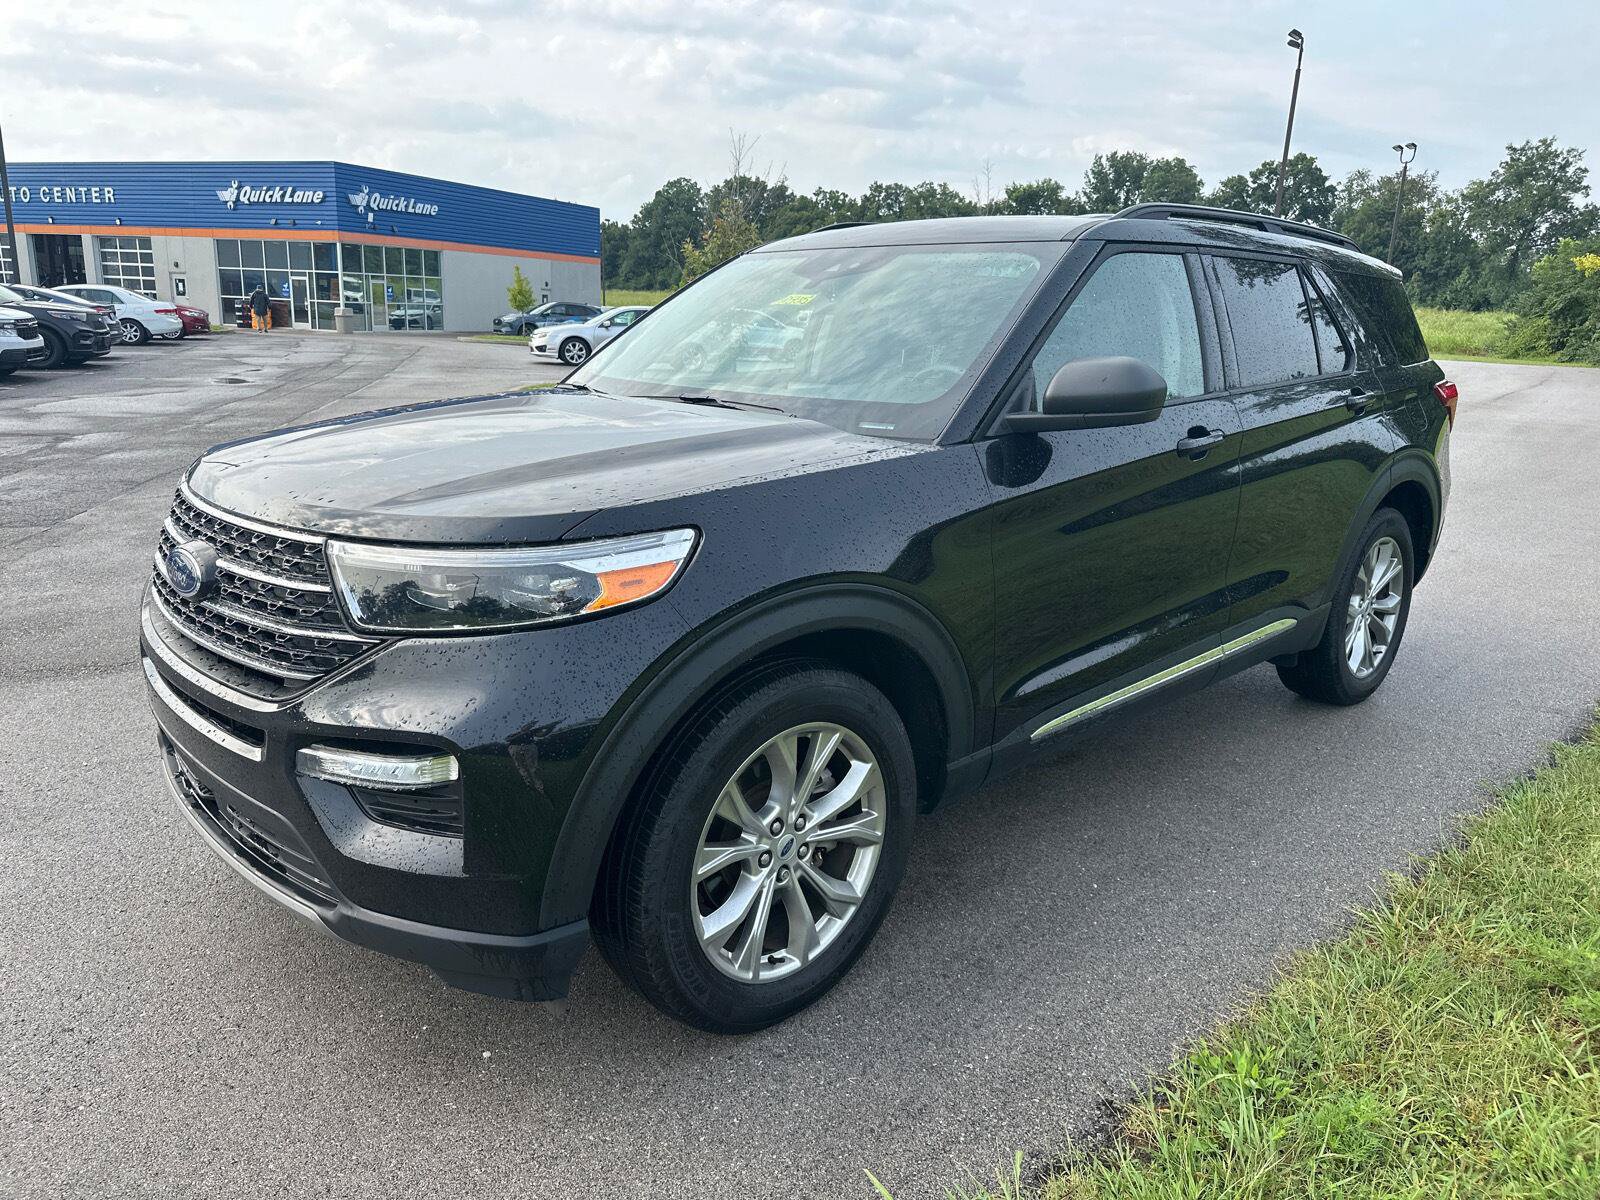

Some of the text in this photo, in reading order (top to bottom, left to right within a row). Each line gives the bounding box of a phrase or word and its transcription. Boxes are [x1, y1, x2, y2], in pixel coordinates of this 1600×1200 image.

[39, 186, 115, 203] CENTER
[239, 186, 323, 205] Quick Lane
[369, 193, 439, 217] Quick Lane
